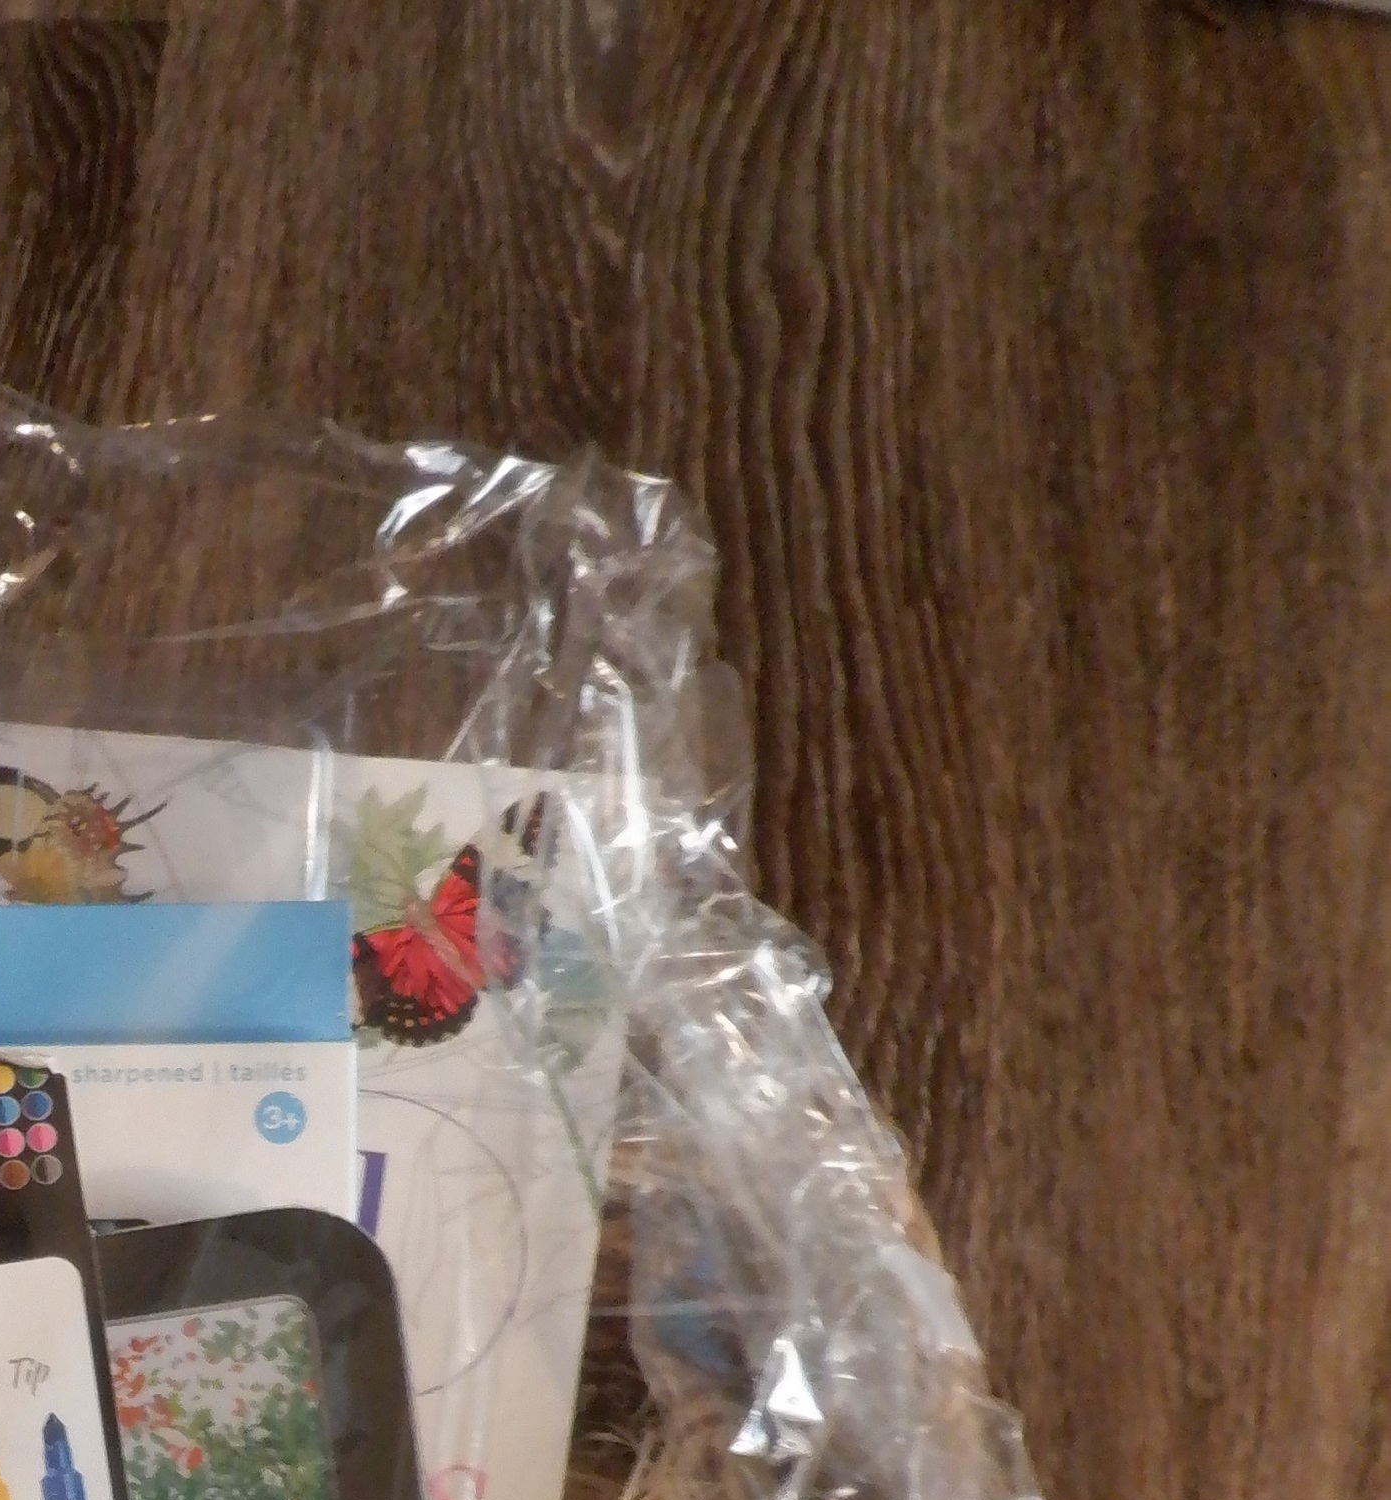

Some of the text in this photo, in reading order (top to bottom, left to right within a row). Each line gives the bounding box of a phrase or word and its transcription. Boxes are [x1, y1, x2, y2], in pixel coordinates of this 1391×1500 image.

[72, 1062, 204, 1085] sharpened
[262, 1104, 300, 1131] 3+
[8, 1357, 51, 1397] Tip
